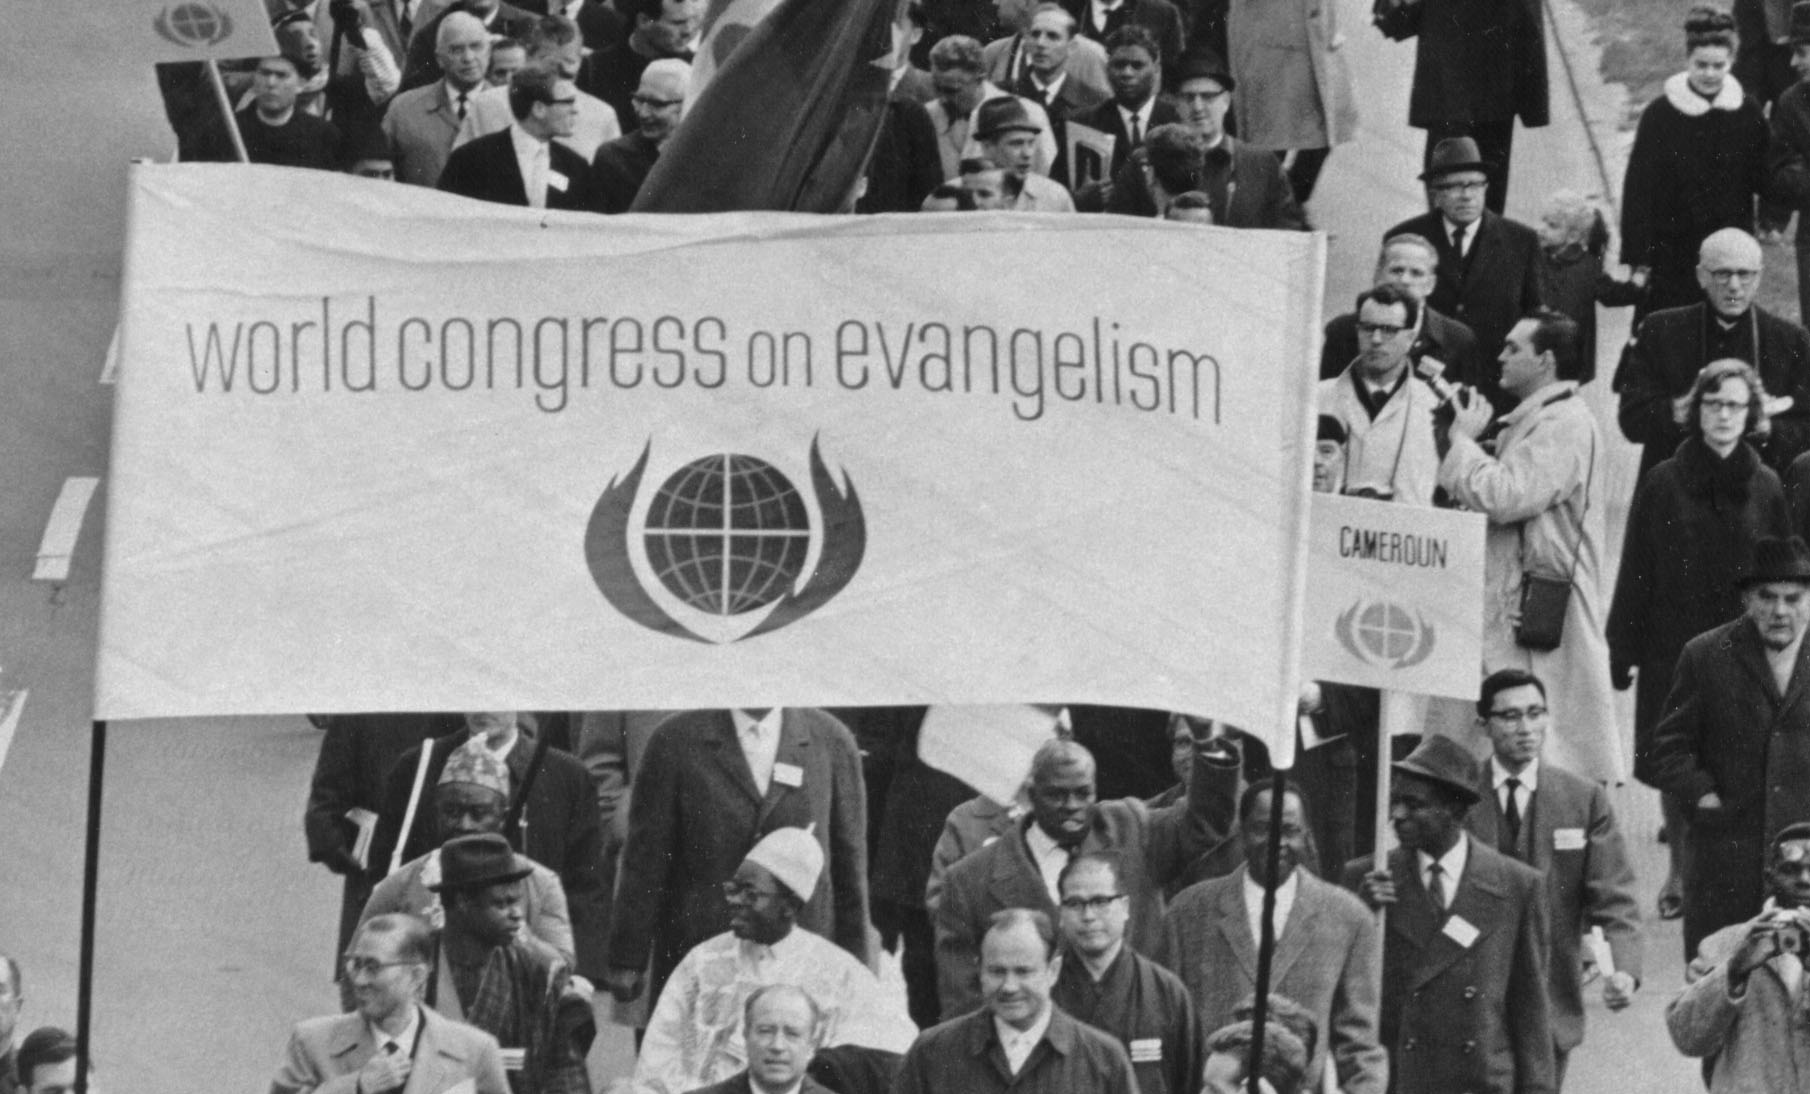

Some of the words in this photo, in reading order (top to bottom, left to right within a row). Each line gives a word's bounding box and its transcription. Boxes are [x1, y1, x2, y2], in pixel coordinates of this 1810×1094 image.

[186, 294, 377, 396] world
[398, 314, 727, 414] congress
[747, 330, 813, 389] on
[835, 316, 1222, 425] evangelism
[1339, 525, 1448, 569] CAMEROUN
